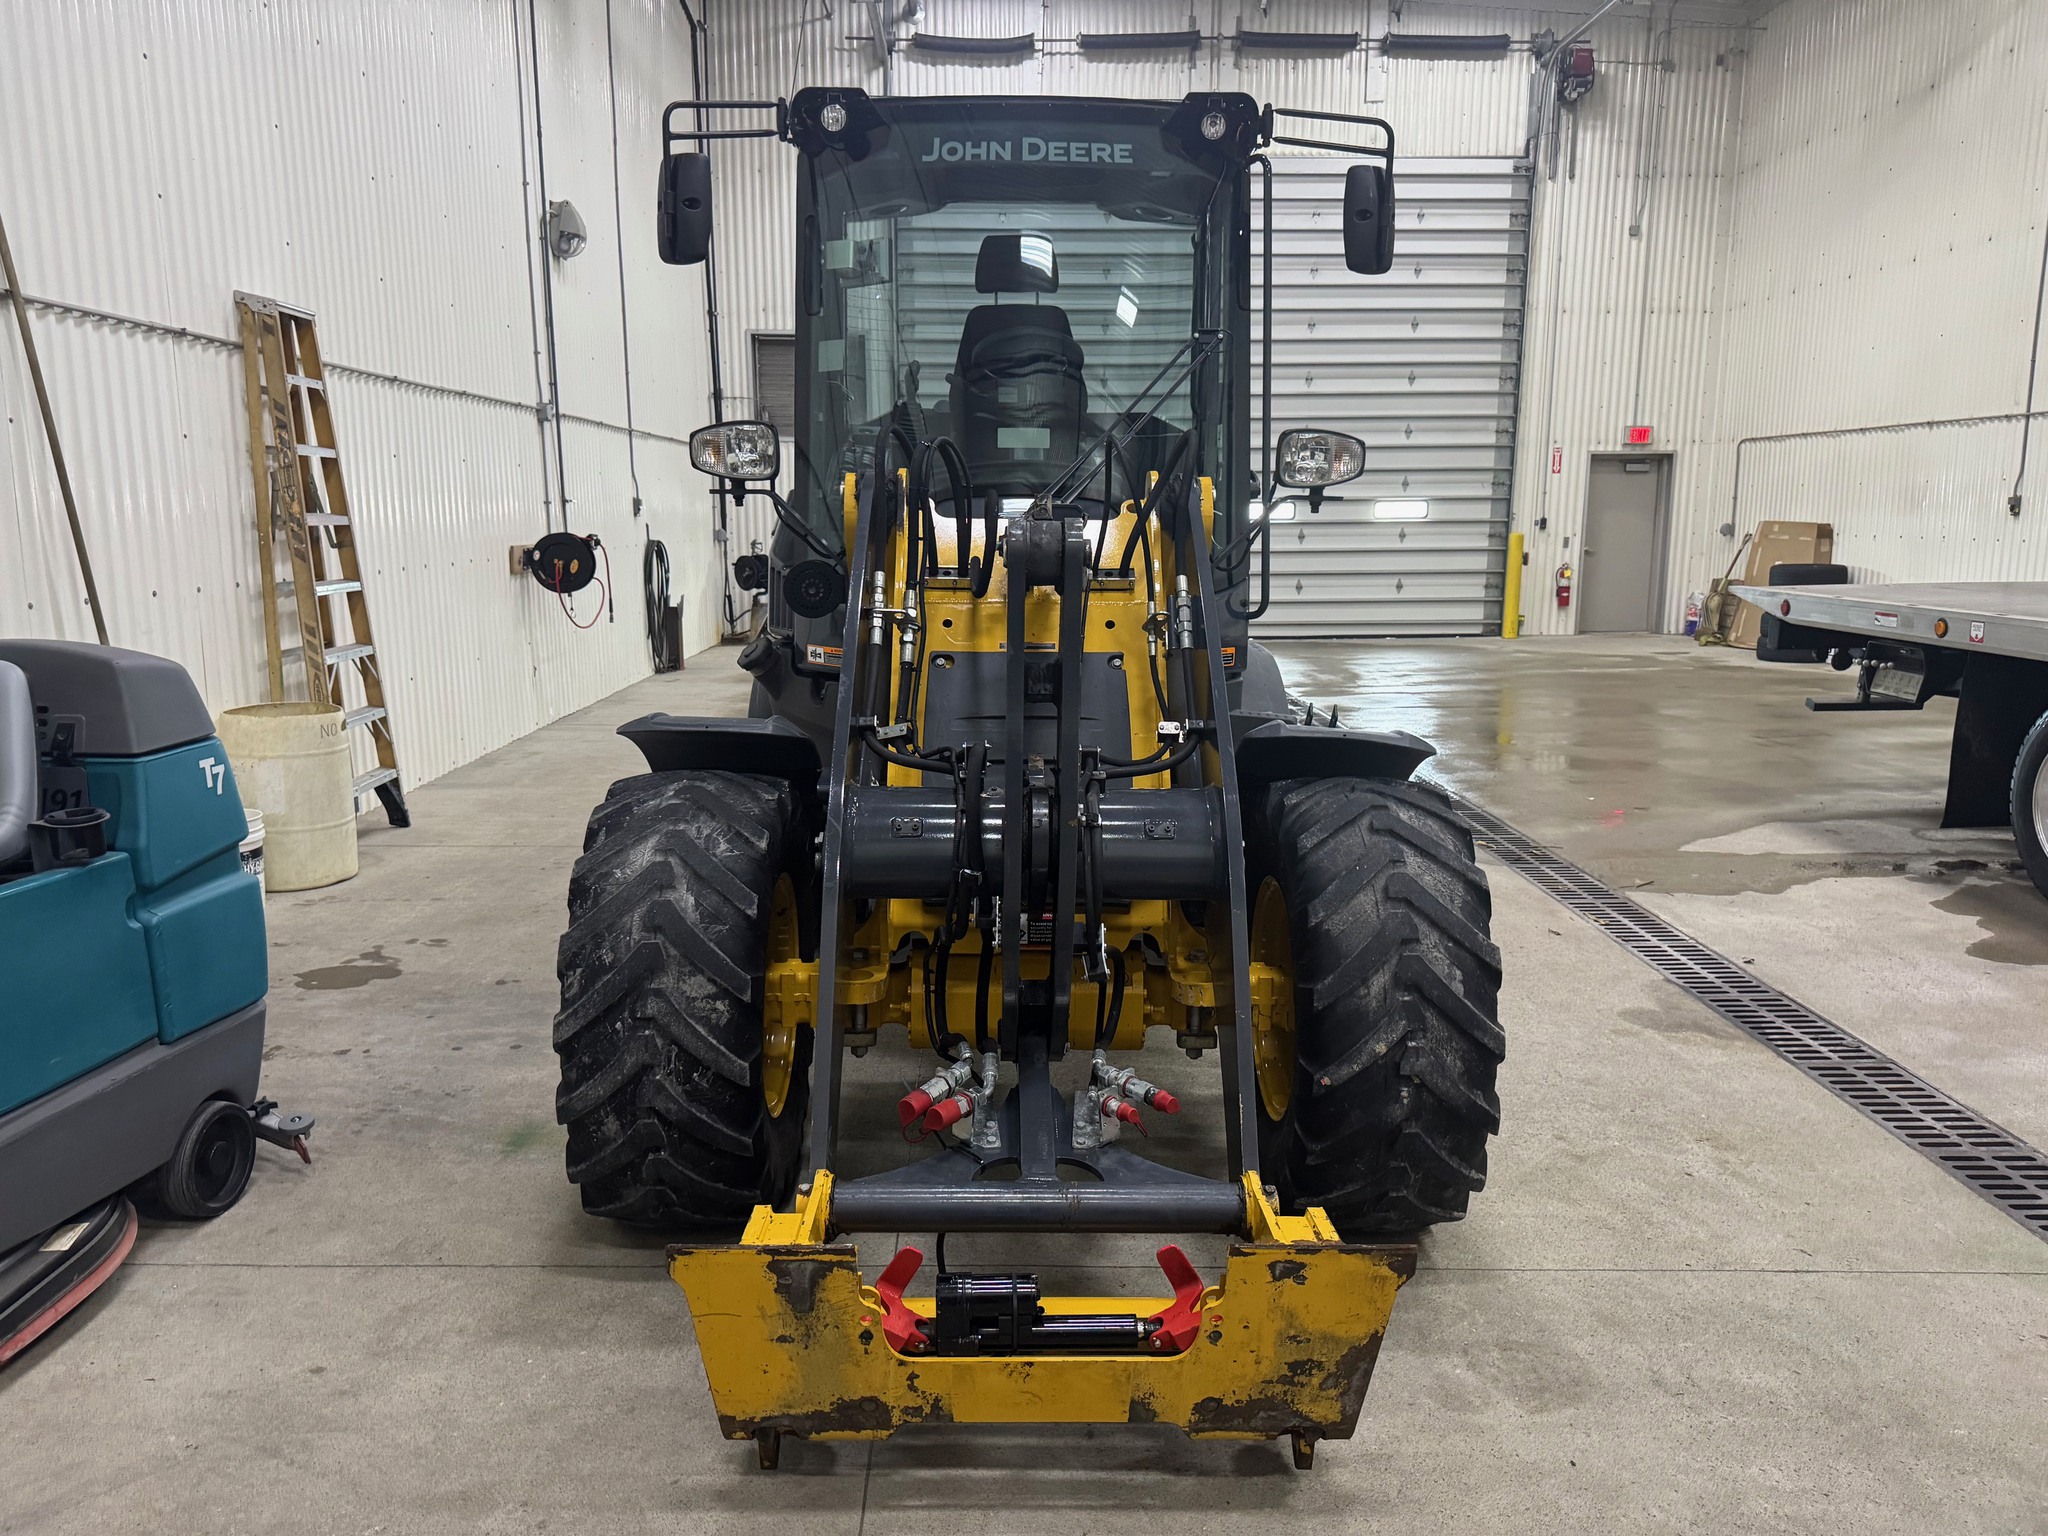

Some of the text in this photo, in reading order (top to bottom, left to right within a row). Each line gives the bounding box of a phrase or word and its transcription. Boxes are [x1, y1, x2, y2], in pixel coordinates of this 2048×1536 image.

[921, 137, 1133, 164] JOHN DEERE
[1630, 427, 1651, 443] EXIT
[320, 722, 338, 739] NO
[198, 757, 225, 795] T7
